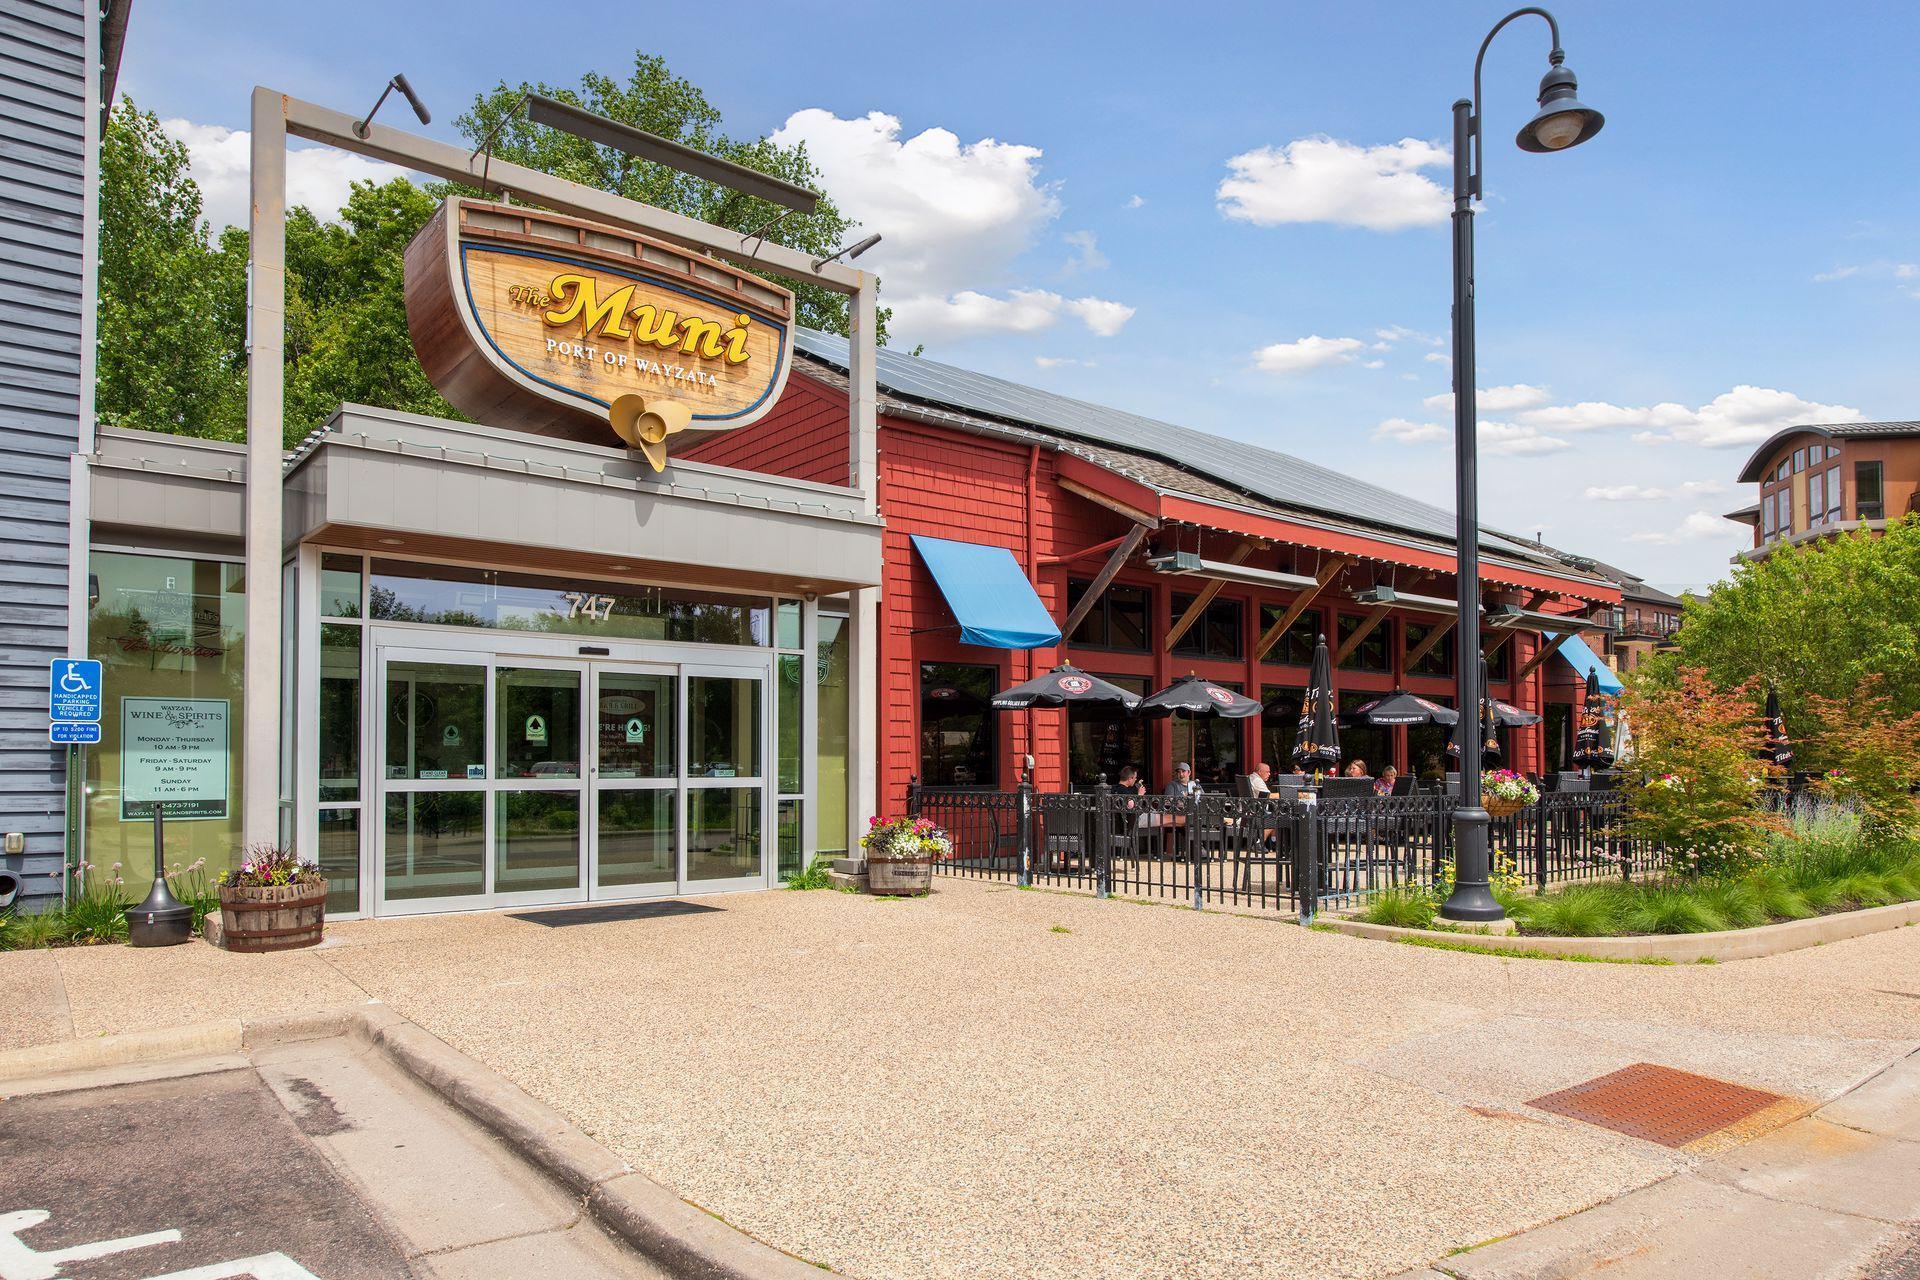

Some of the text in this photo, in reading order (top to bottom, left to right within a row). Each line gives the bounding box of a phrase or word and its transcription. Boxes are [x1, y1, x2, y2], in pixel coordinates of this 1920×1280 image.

[508, 272, 752, 364] The Muni
[546, 337, 718, 387] PORT OF WAYZATA
[565, 594, 616, 621] 747
[130, 709, 223, 721] WINE & SPIRITS
[598, 723, 617, 732] E'RE
